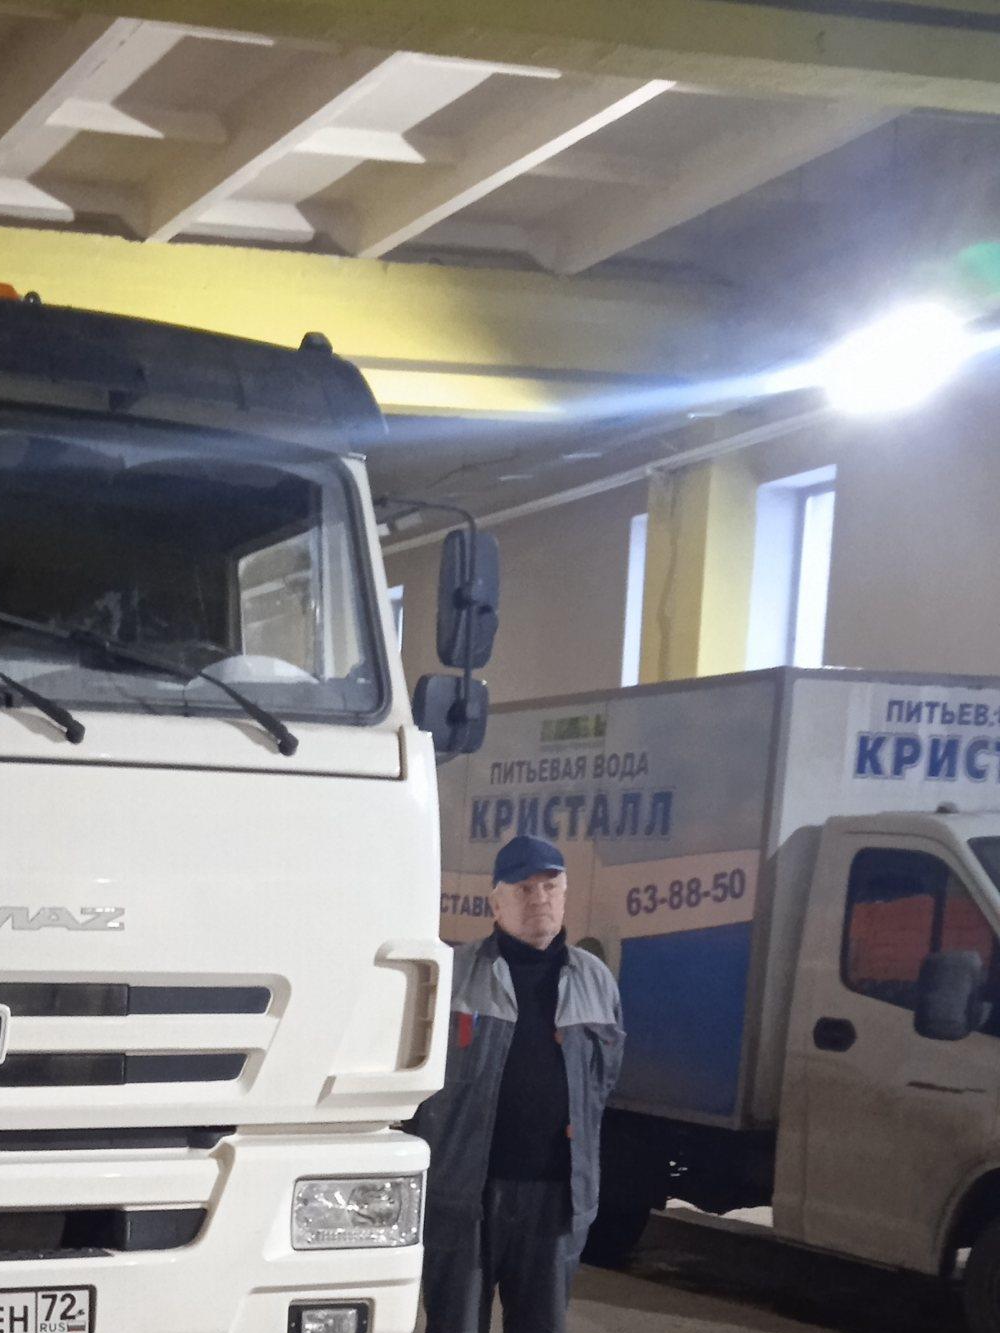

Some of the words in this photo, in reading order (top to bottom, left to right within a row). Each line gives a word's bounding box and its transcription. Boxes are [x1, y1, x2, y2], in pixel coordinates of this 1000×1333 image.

[489, 756, 587, 785] ПИТЬЕВАЯ
[592, 751, 649, 782] ВОДА
[855, 733, 1000, 780] КРИС
[470, 788, 674, 841] КРИСТАЛЛ
[626, 868, 746, 916] 63-88-50
[39, 1321, 66, 1333] RUS
[41, 1293, 78, 1321] 72
